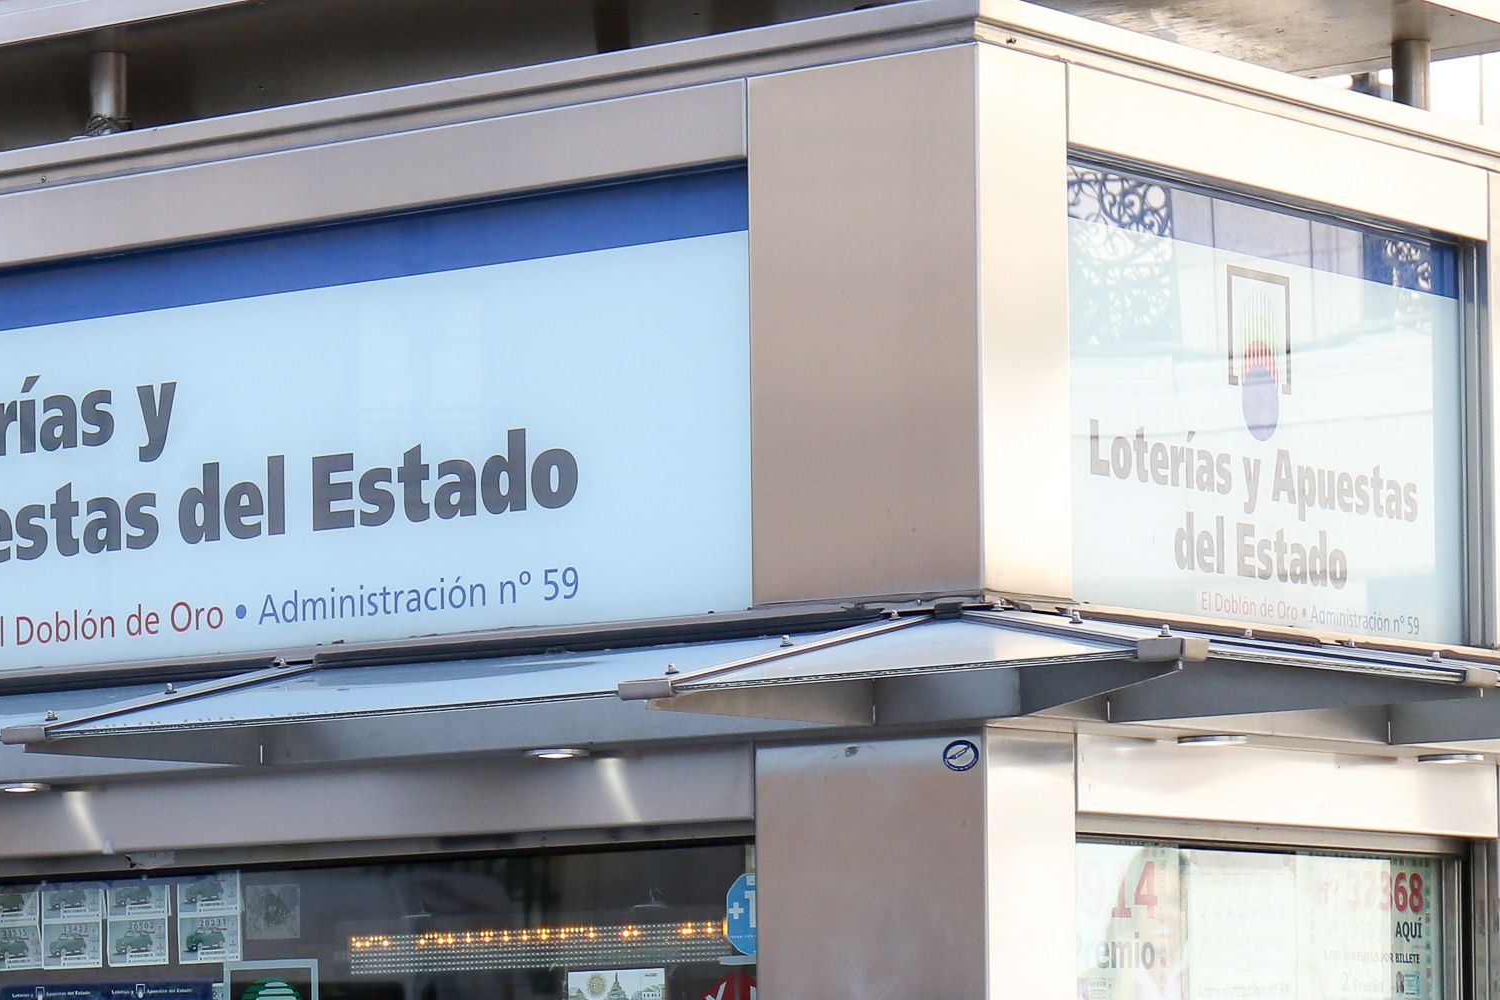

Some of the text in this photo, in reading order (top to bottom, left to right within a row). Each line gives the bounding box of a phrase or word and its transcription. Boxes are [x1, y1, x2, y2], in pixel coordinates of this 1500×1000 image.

[136, 381, 177, 462] y
[178, 454, 286, 544] del
[312, 428, 579, 532] Estado
[1090, 417, 1418, 523] Loterías y Apuestas
[1174, 510, 1348, 590] del Estado
[15, 604, 116, 646] Doblón
[126, 603, 160, 638] de
[170, 600, 224, 632] Oro
[258, 575, 487, 627] Administración
[498, 571, 532, 604] nº
[543, 566, 580, 600] 59
[1201, 591, 1212, 611] El
[1215, 592, 1258, 617] Doblón
[1260, 597, 1274, 618] de
[1277, 600, 1298, 622] Oro
[1310, 603, 1390, 630] Administración
[1407, 614, 1420, 635] 59
[1381, 952, 1394, 963] POR
[1396, 953, 1420, 964] BILLETE
[1396, 918, 1422, 942] AQUÍ
